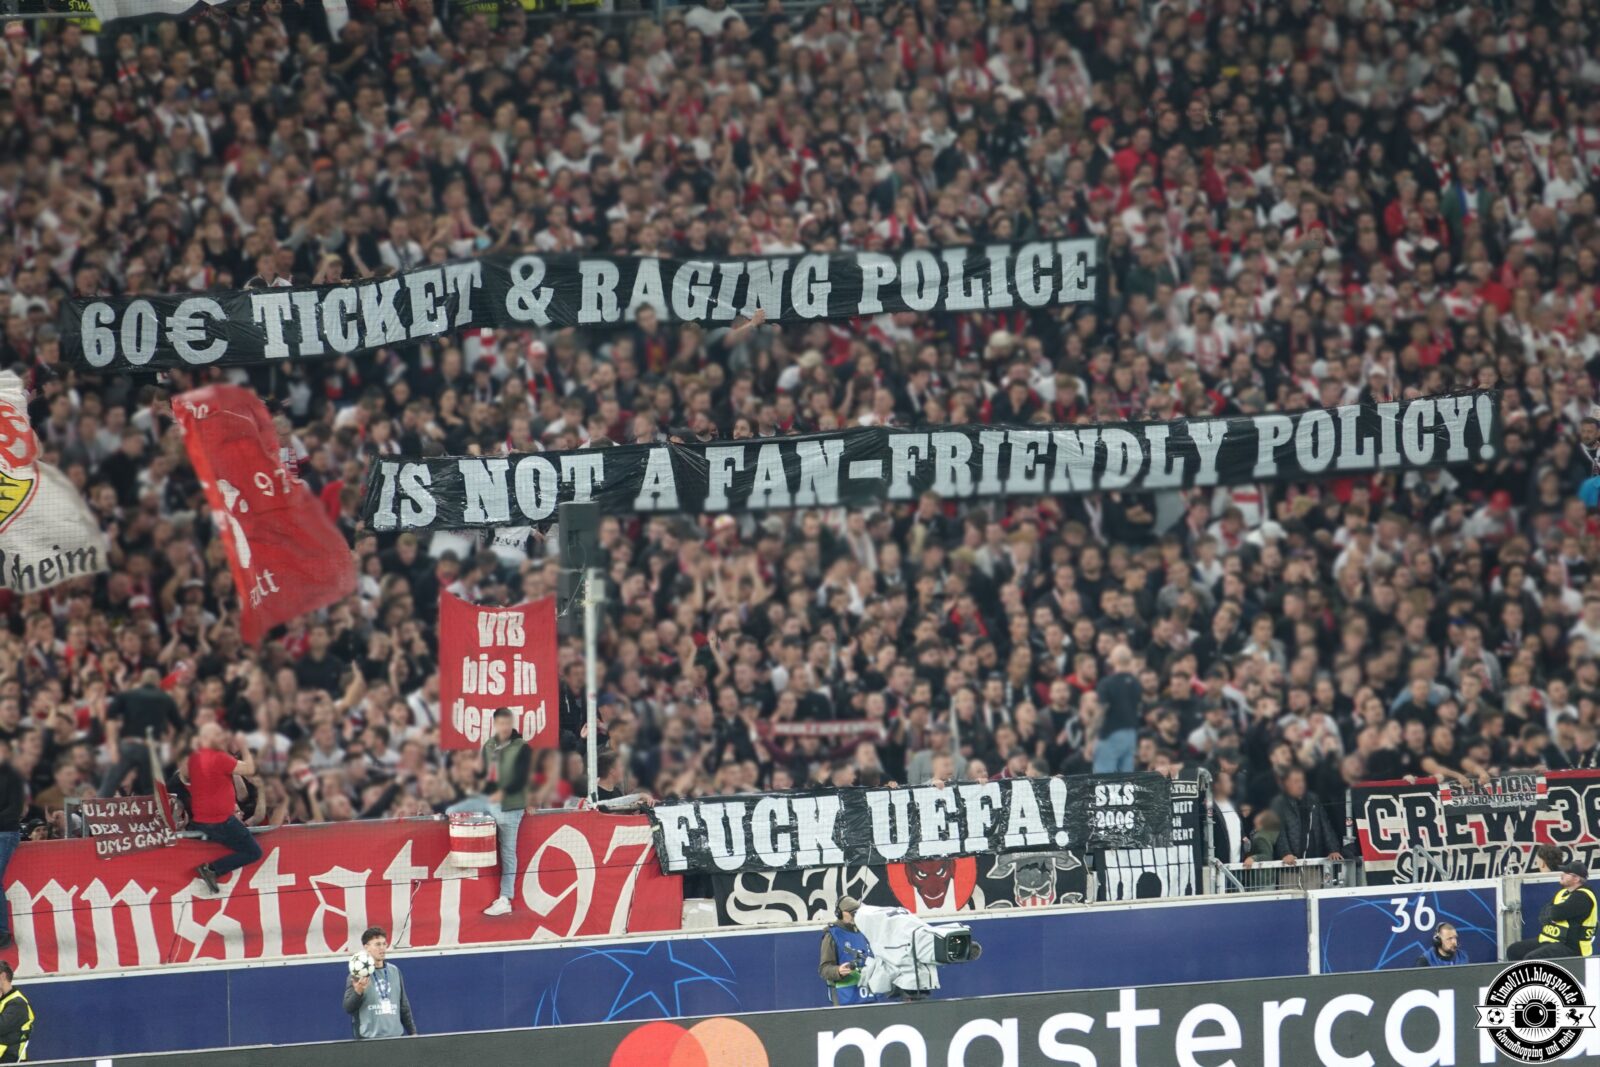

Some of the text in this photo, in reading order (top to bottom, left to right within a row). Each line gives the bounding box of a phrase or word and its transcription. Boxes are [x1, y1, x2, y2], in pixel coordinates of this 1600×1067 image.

[81, 238, 1097, 367] 60€ TICKET & RAGING POLICE
[373, 461, 437, 530] IS
[458, 453, 604, 522] NOT
[633, 447, 680, 509] A
[1253, 394, 1496, 477] POLICY!
[462, 653, 538, 696] bis in
[82, 800, 141, 818] ULTRA
[1170, 783, 1197, 795] TRAS
[89, 823, 124, 836] DER
[655, 778, 1070, 871] FUCK UEFA!
[1096, 811, 1135, 830] 2006
[1365, 791, 1537, 854] CREW
[96, 836, 132, 855] UMS
[521, 824, 654, 941] 97
[1390, 896, 1436, 933] 36
